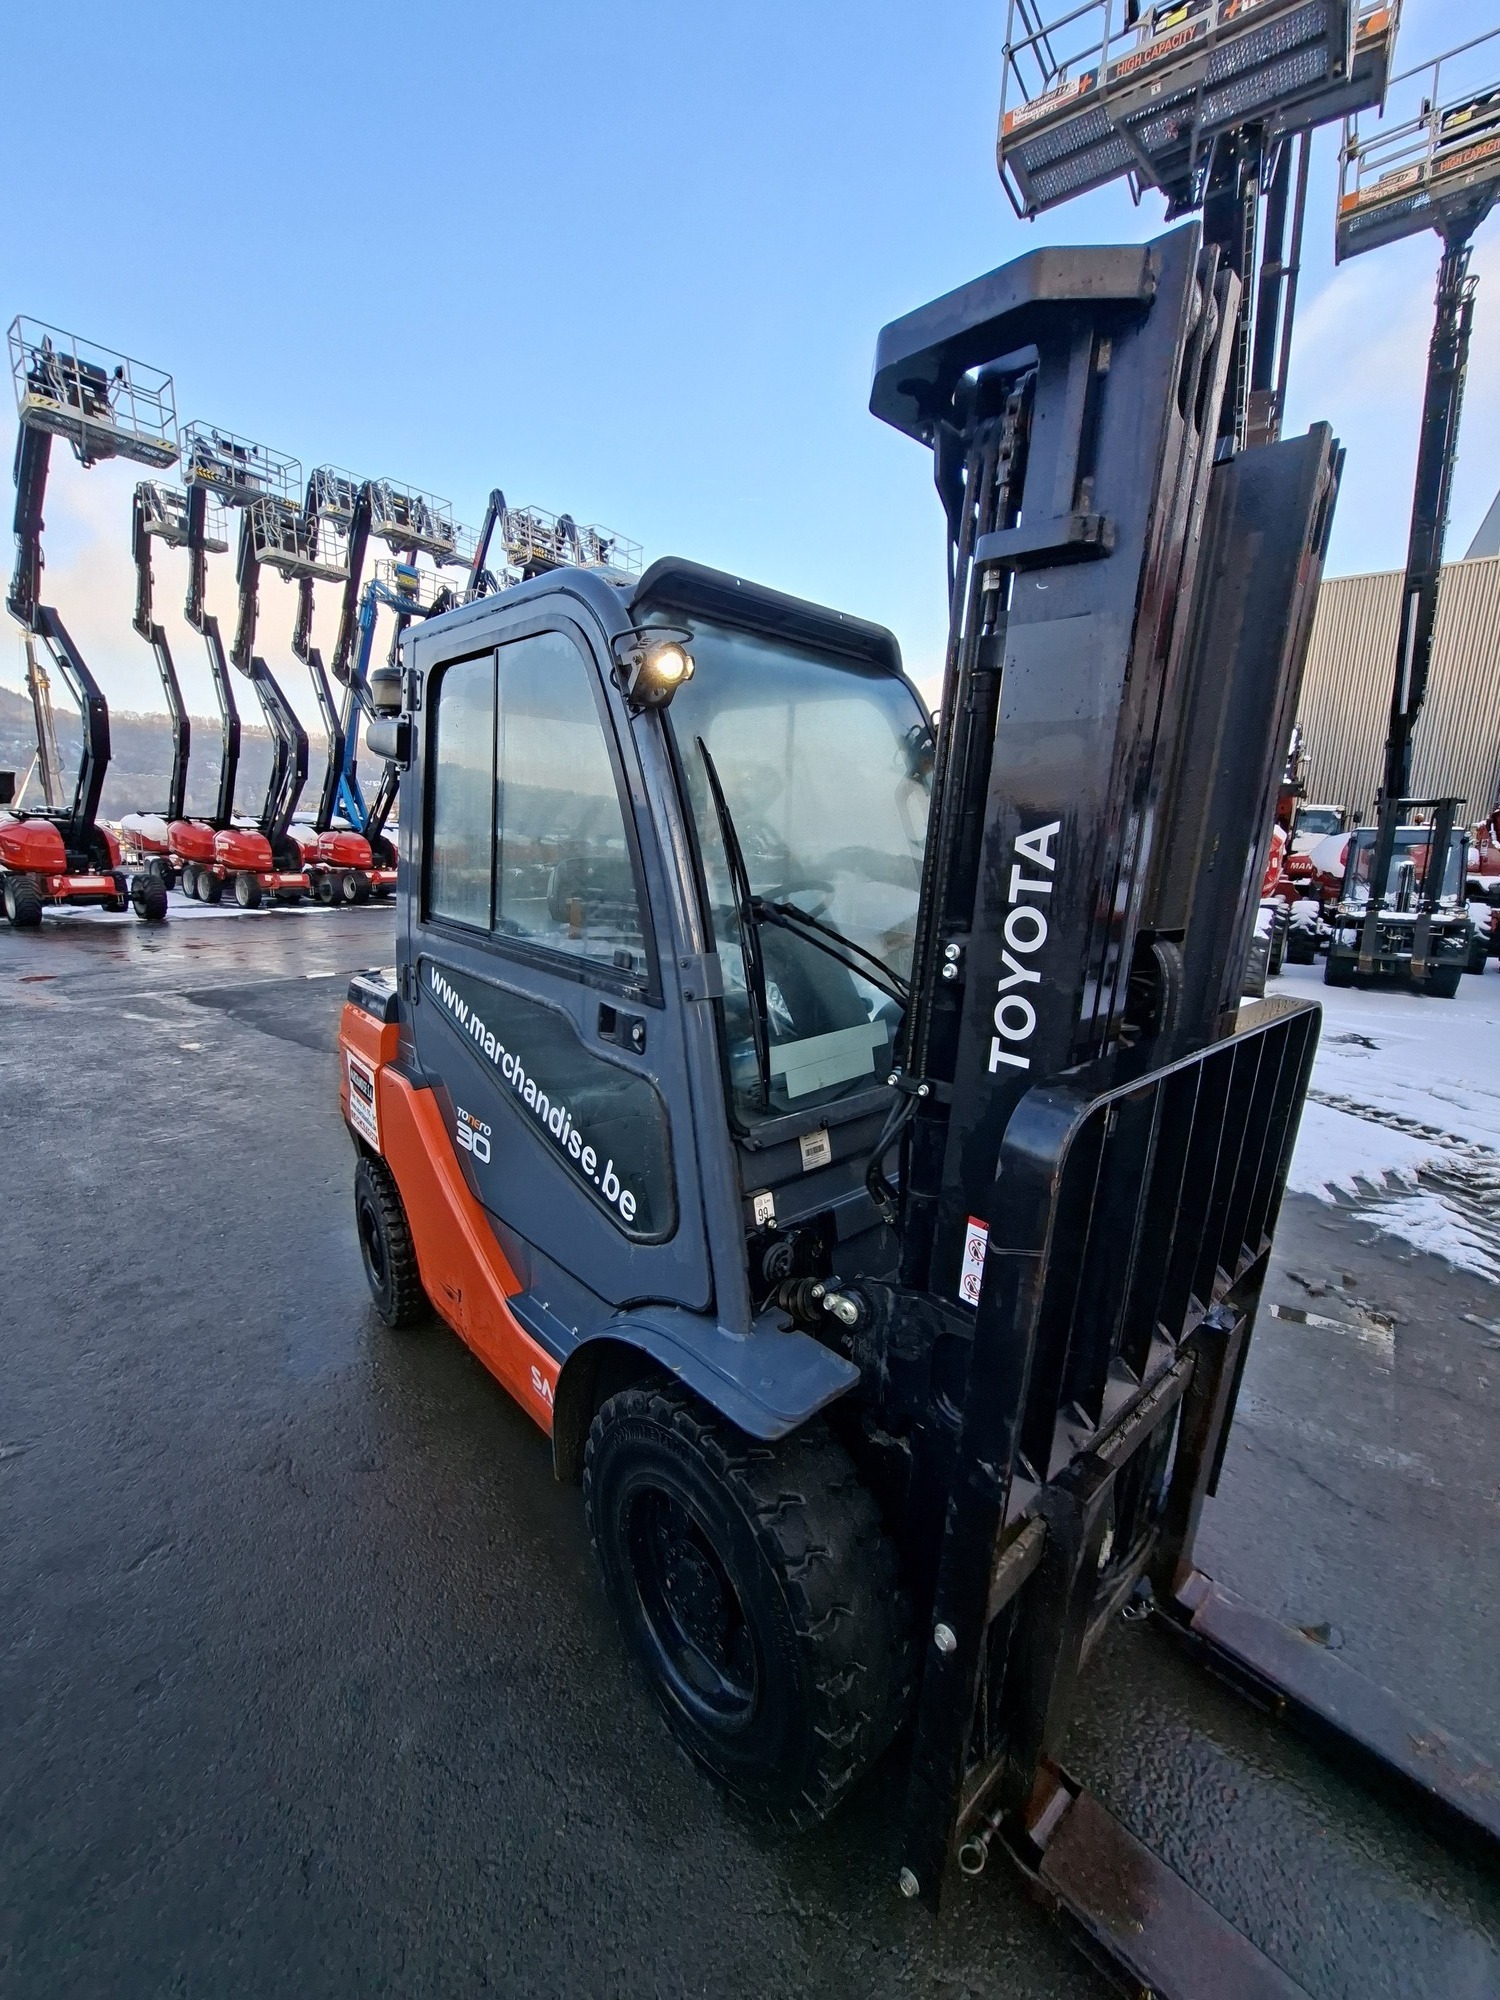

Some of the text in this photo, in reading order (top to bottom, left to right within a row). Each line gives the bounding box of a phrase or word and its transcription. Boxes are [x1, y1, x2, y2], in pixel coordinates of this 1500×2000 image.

[1116, 24, 1197, 77] HIGH CAPACITY
[988, 820, 1061, 1073] TOYOTA
[430, 966, 638, 1223] www.marchandise.be
[456, 1120, 491, 1164] 30
[758, 1206, 769, 1222] 99
